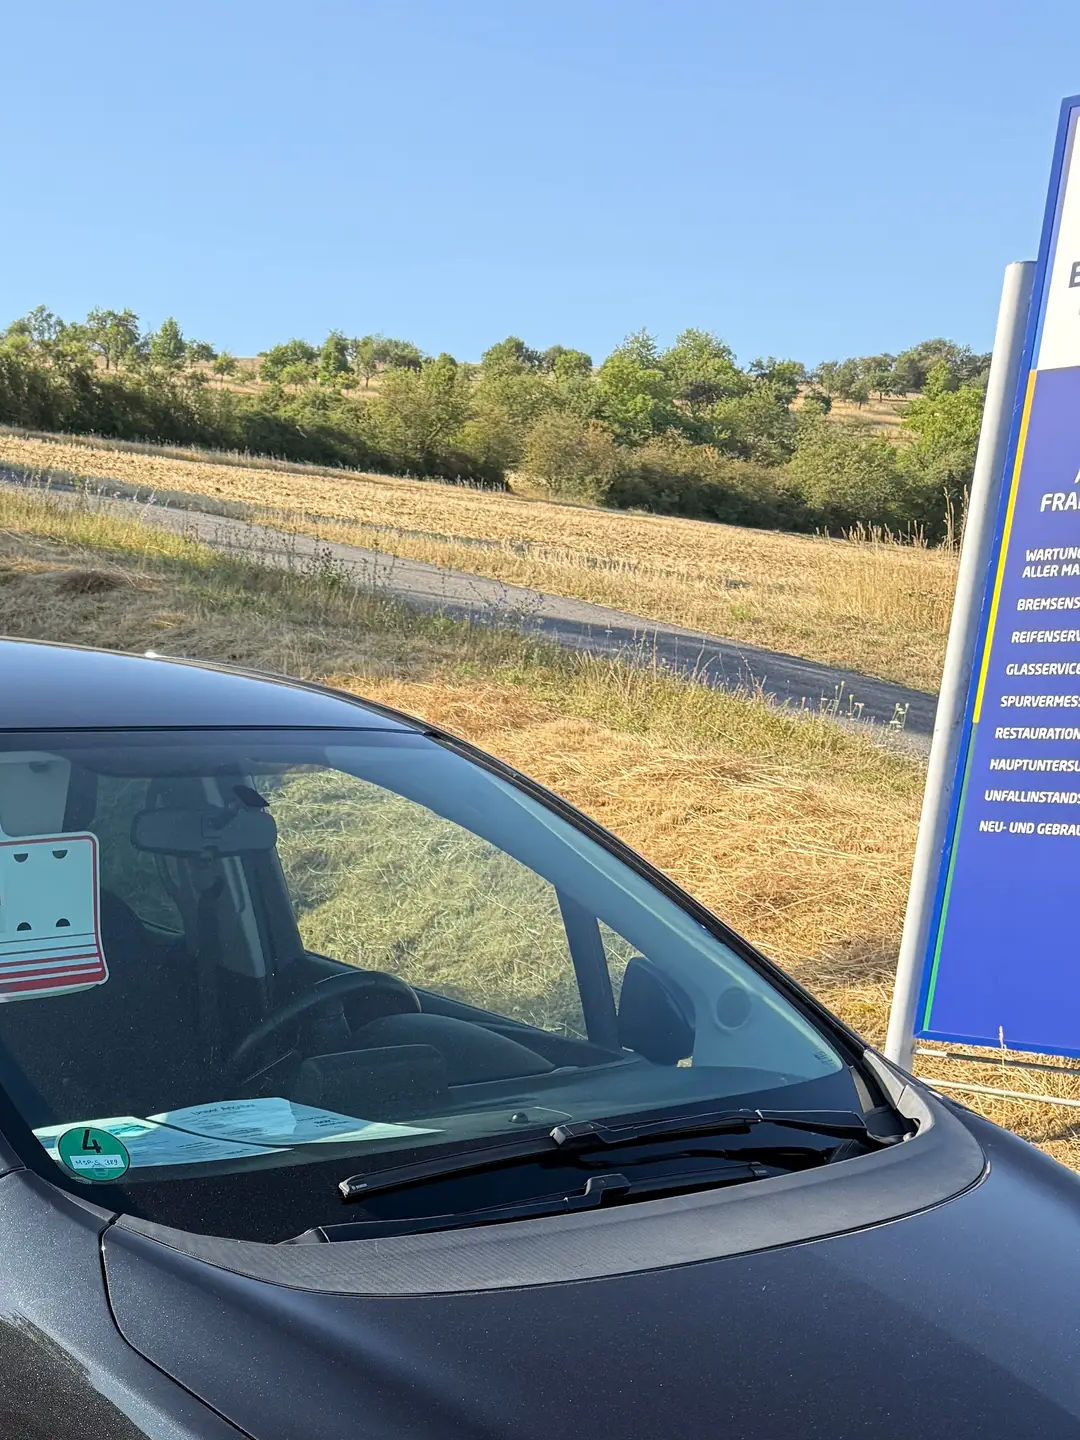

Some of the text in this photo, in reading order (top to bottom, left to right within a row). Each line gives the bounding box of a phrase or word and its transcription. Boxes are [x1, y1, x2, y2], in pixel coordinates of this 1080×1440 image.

[1040, 491, 1080, 512] FRA
[1021, 564, 1059, 579] ALLER
[1017, 596, 1080, 611] BREMSENS
[1000, 695, 1080, 708] SPURVERMES
[995, 727, 1080, 740] RESTAURATION
[979, 820, 1007, 833] NEU-
[1009, 821, 1035, 835] UND
[82, 1129, 102, 1154] 4
